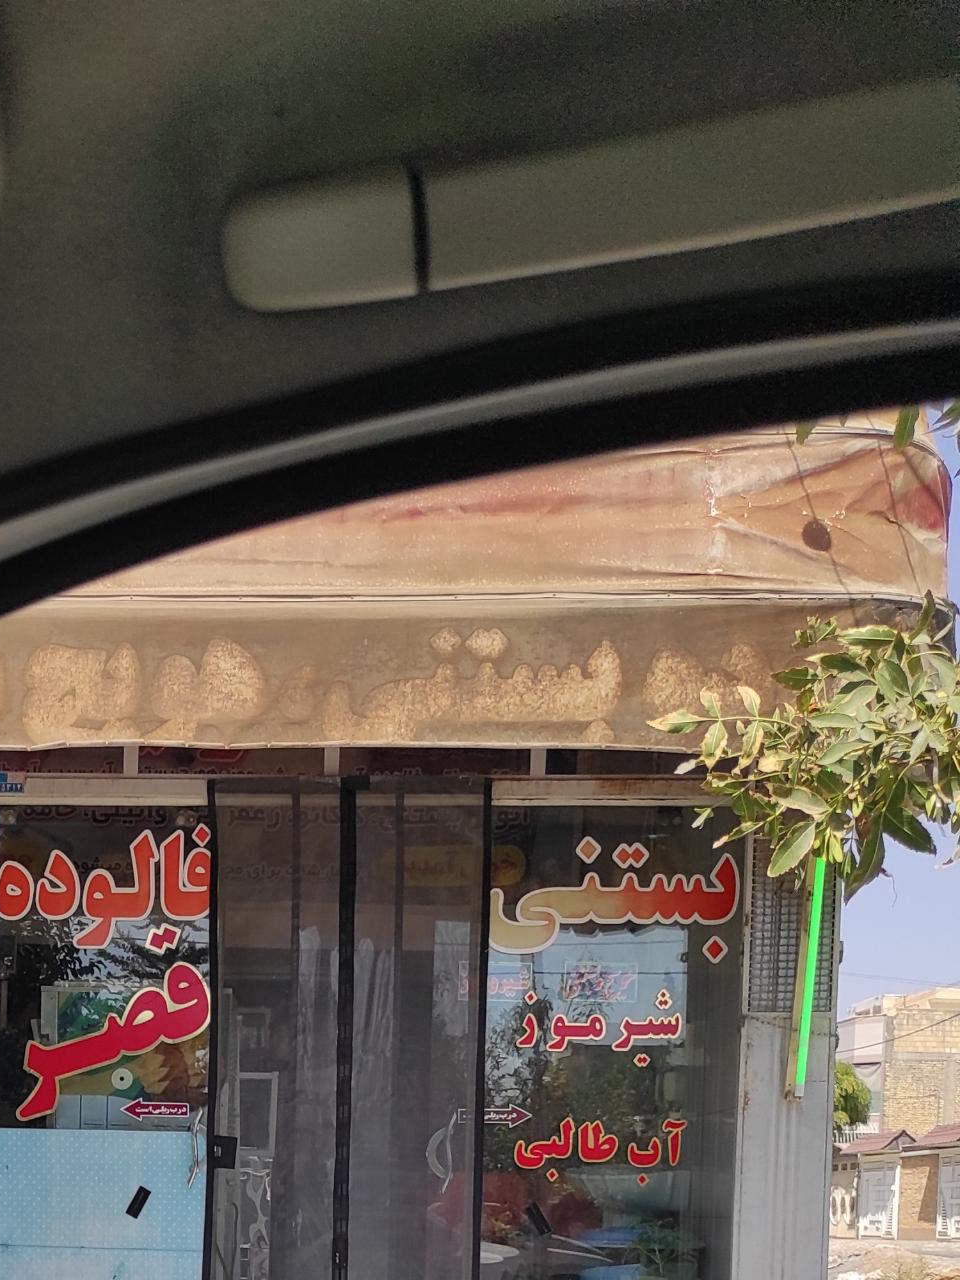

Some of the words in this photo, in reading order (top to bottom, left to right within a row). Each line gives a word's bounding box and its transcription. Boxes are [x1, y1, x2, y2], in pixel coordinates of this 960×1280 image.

[488, 836, 740, 964] بستنی
[16, 926, 211, 1122] قصر
[514, 1117, 619, 1182] طالبی
[628, 1119, 687, 1185] آب
